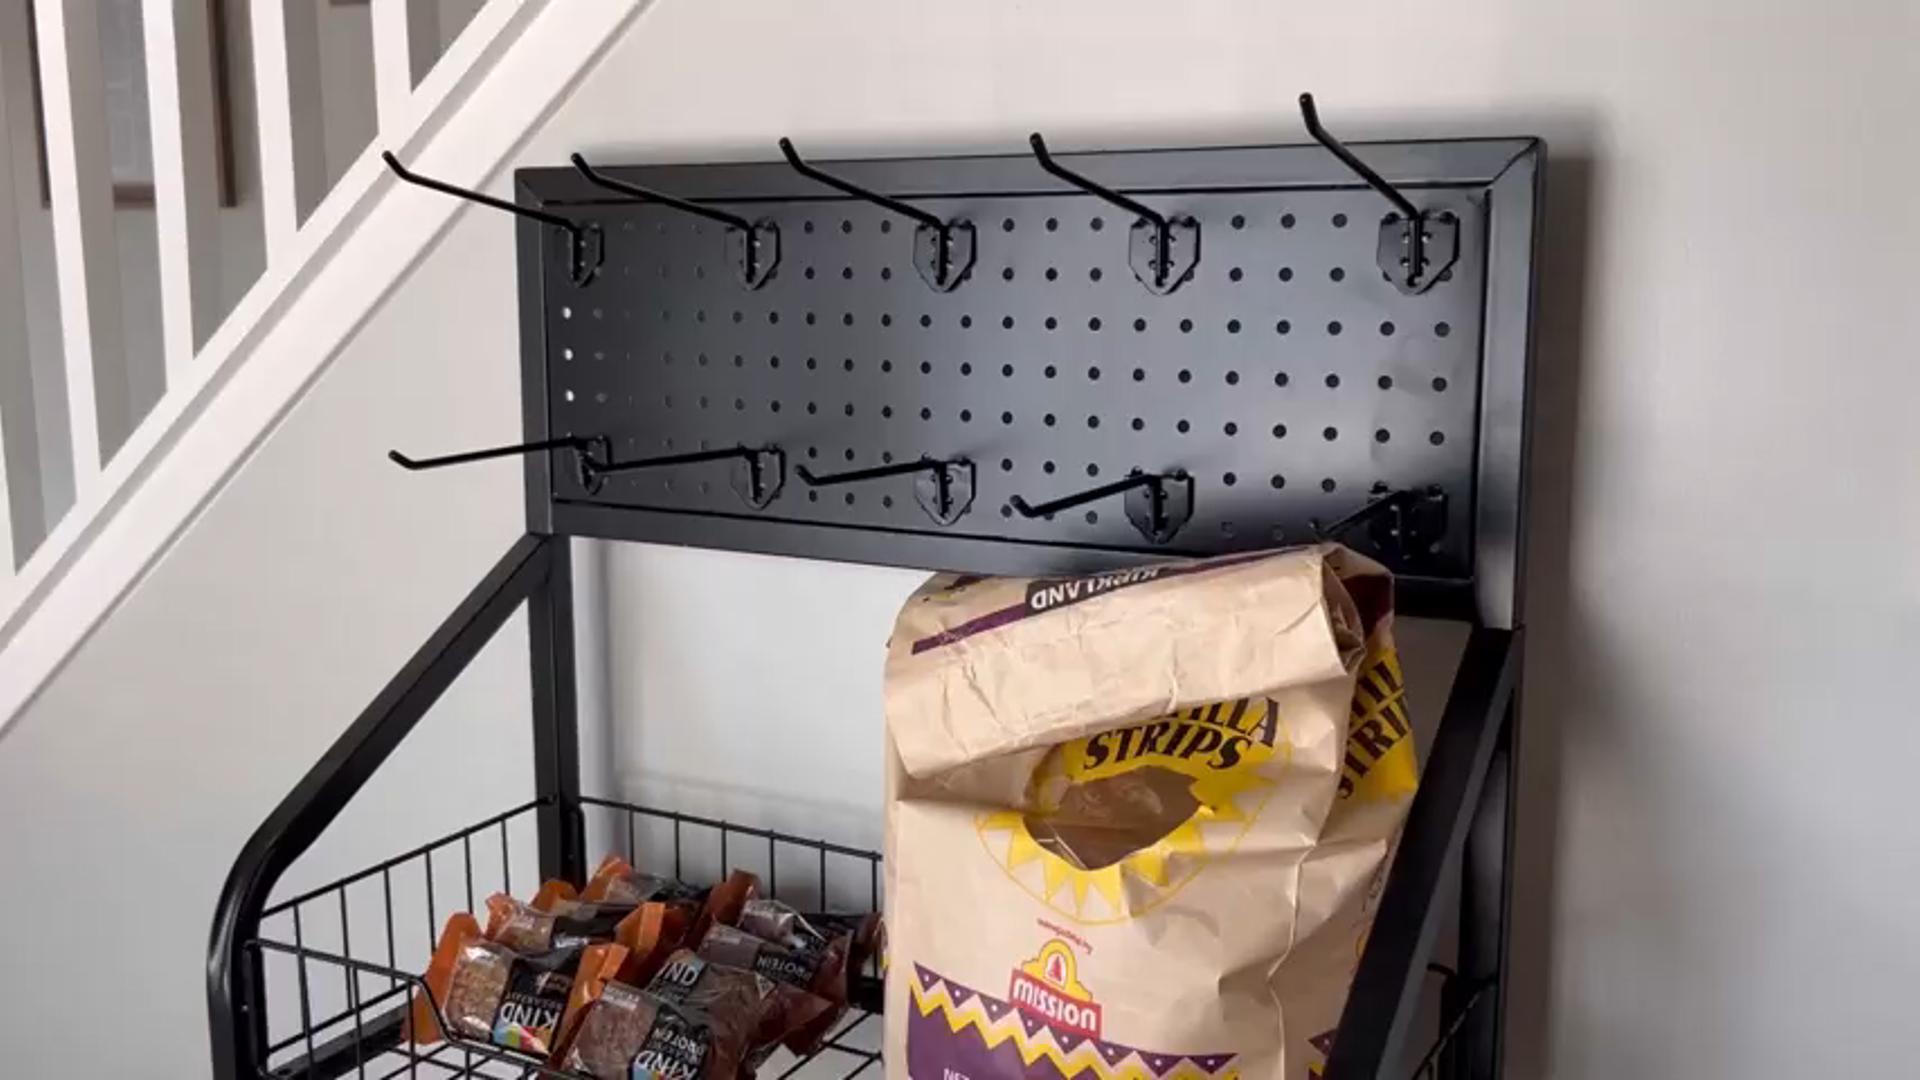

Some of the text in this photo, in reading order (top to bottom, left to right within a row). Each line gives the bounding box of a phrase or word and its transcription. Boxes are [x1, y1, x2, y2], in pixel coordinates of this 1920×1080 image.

[1083, 721, 1252, 770] STRIPS
[500, 1001, 560, 1032] KIND
[635, 1049, 697, 1080] KIND
